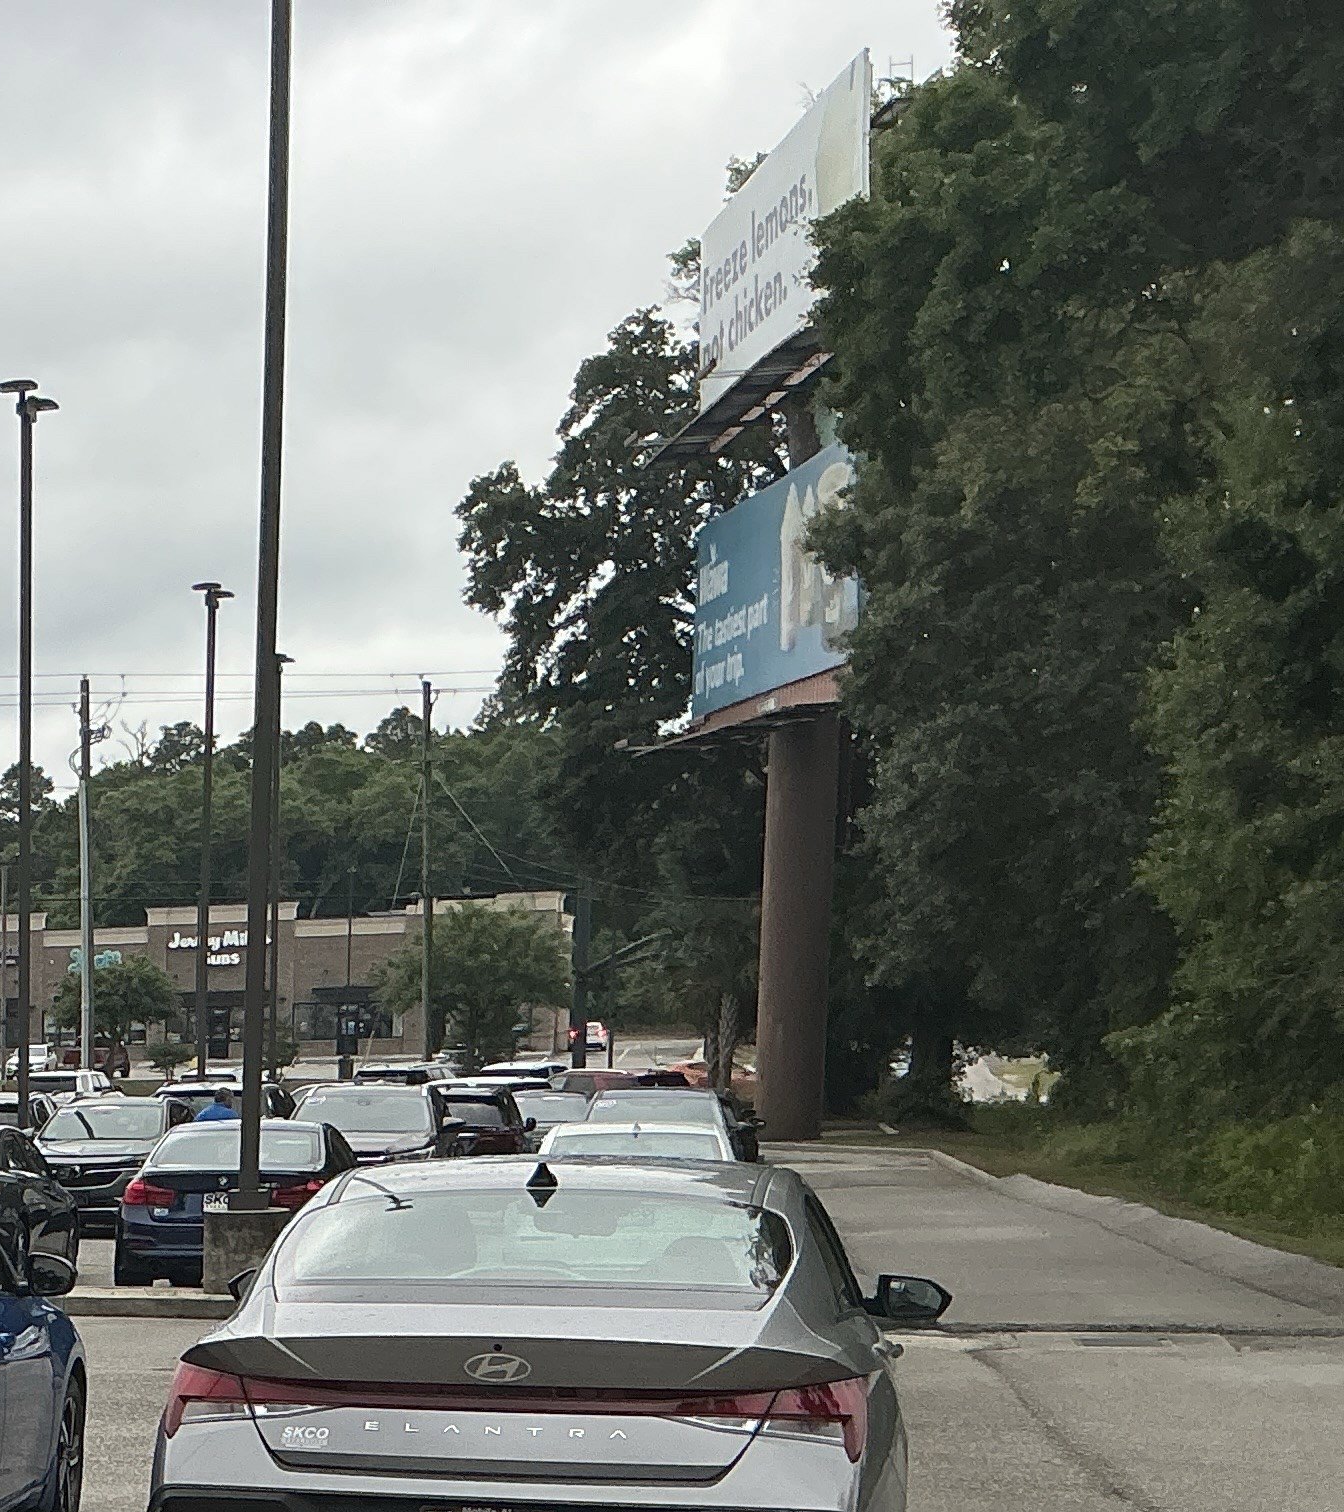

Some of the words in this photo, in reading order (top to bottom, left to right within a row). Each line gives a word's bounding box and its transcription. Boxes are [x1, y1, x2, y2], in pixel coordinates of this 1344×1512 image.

[703, 239, 748, 315] Freeze
[282, 1426, 330, 1439] SKCO
[364, 1420, 627, 1440] ELANTRA
